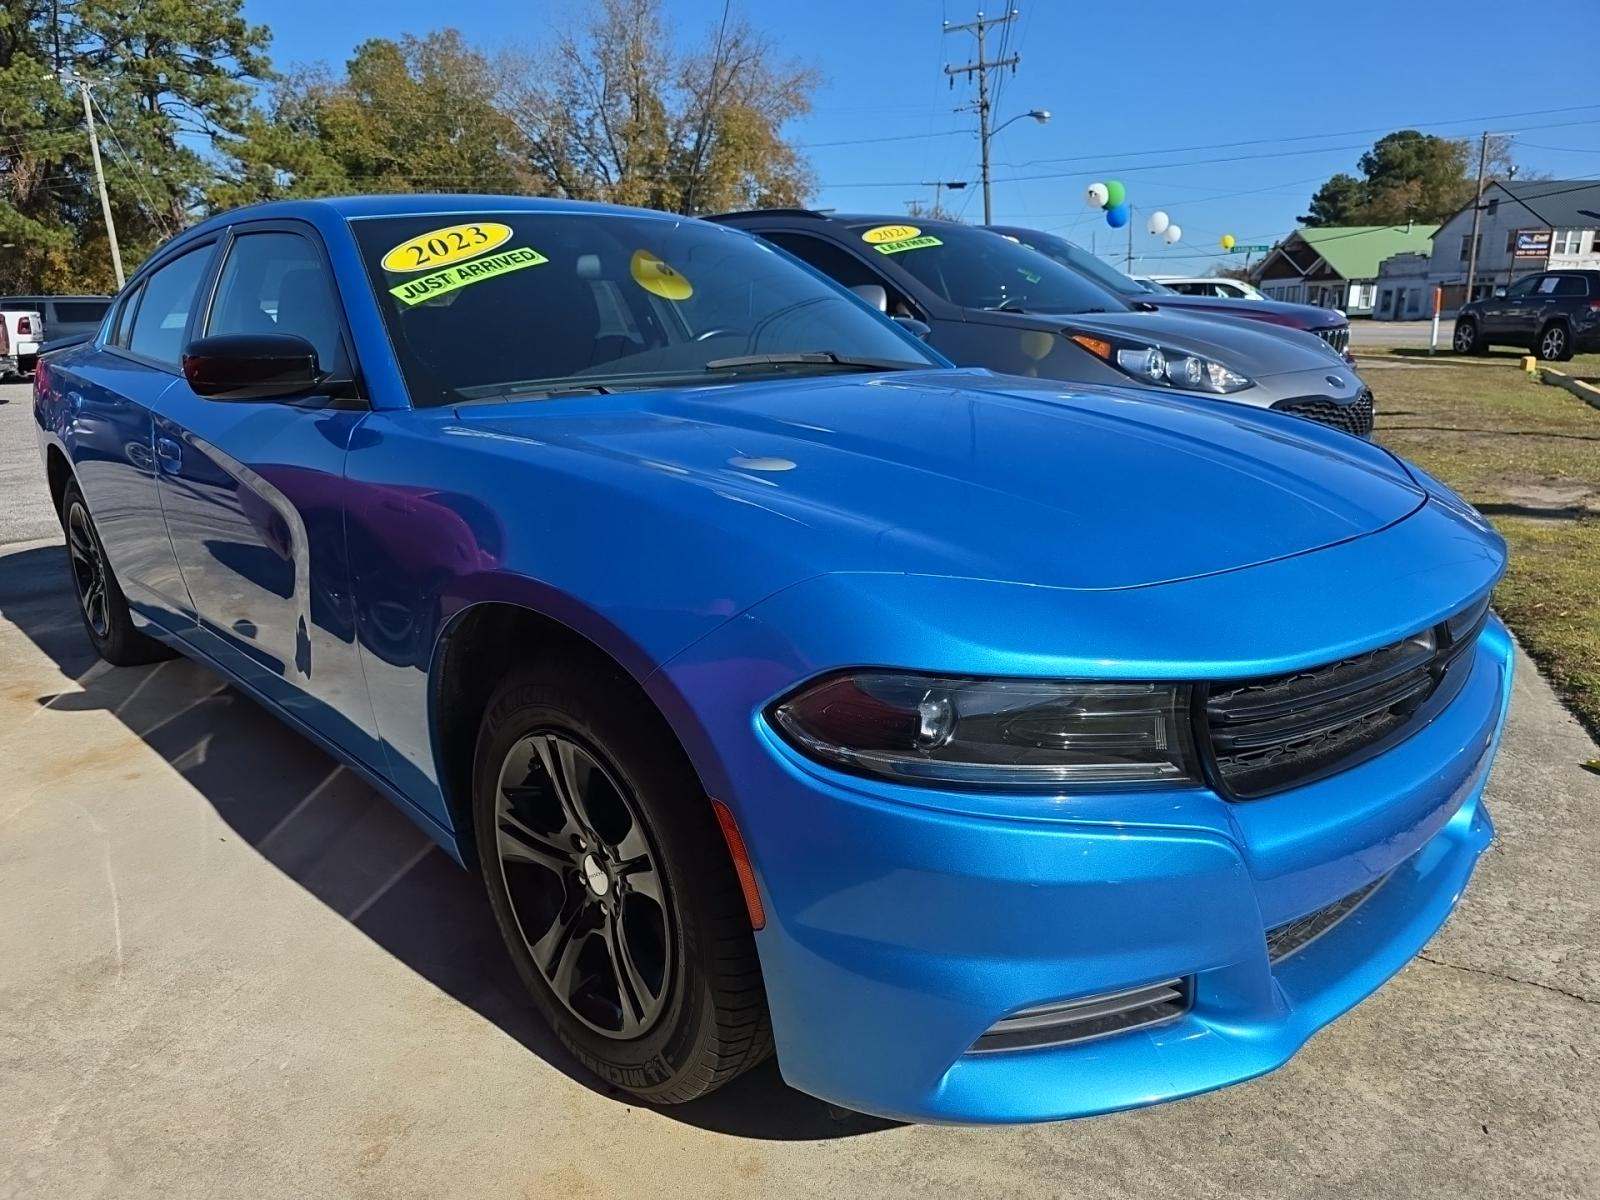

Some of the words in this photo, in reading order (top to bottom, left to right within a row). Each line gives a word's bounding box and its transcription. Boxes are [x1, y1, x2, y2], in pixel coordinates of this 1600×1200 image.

[406, 227, 488, 266] 2023
[880, 238, 935, 251] LEATHER
[404, 273, 451, 299] JUST
[456, 250, 537, 280] ARRIVED
